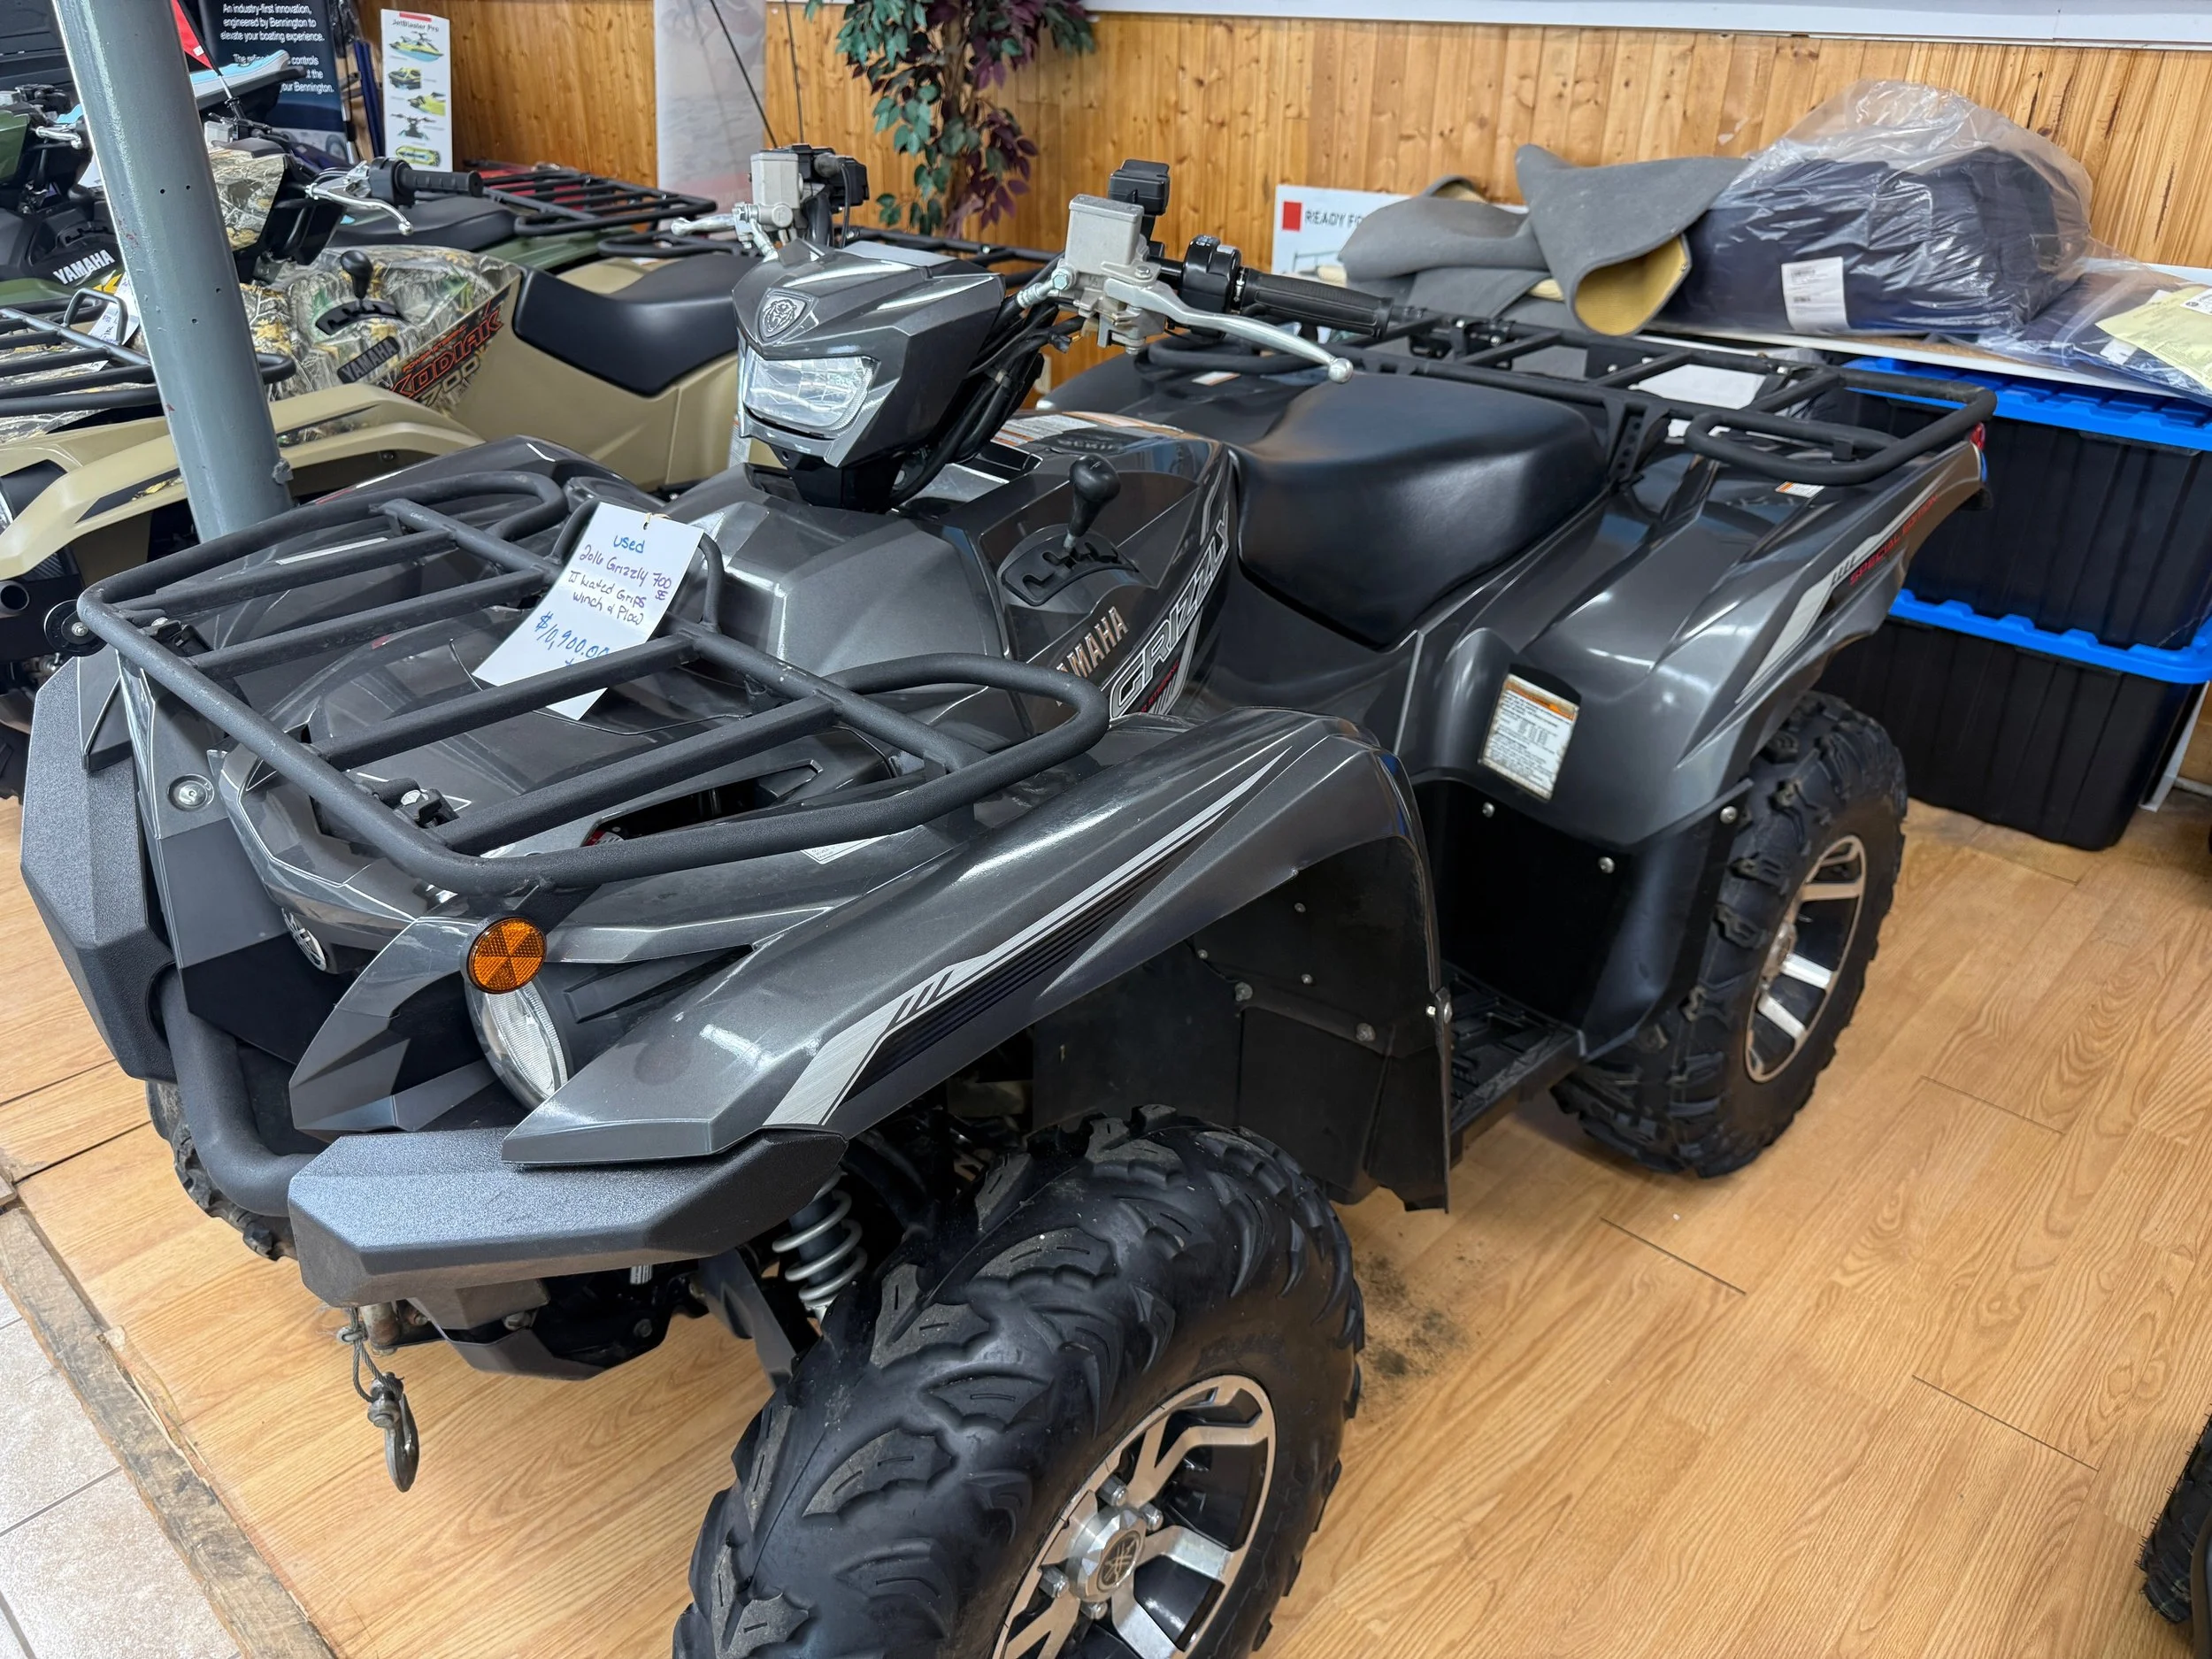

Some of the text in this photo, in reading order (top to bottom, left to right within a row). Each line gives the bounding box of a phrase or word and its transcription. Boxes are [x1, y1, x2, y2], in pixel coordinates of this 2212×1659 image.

[223, 4, 312, 15] An industry-first innovation,
[223, 17, 317, 29] engineered by Bennington to
[220, 30, 325, 43] elevate your boating experience.
[291, 56, 319, 65] controls
[311, 69, 324, 79] the
[294, 81, 334, 95] Bennington.
[1305, 211, 1346, 227] READY
[53, 250, 115, 285] YAMAHA
[389, 298, 504, 399] KODIAK
[342, 339, 397, 380] YAMAHA
[416, 356, 480, 408] 700
[580, 543, 604, 565] 2016
[653, 572, 672, 590] 700
[1110, 501, 1230, 721] GRIZZLY
